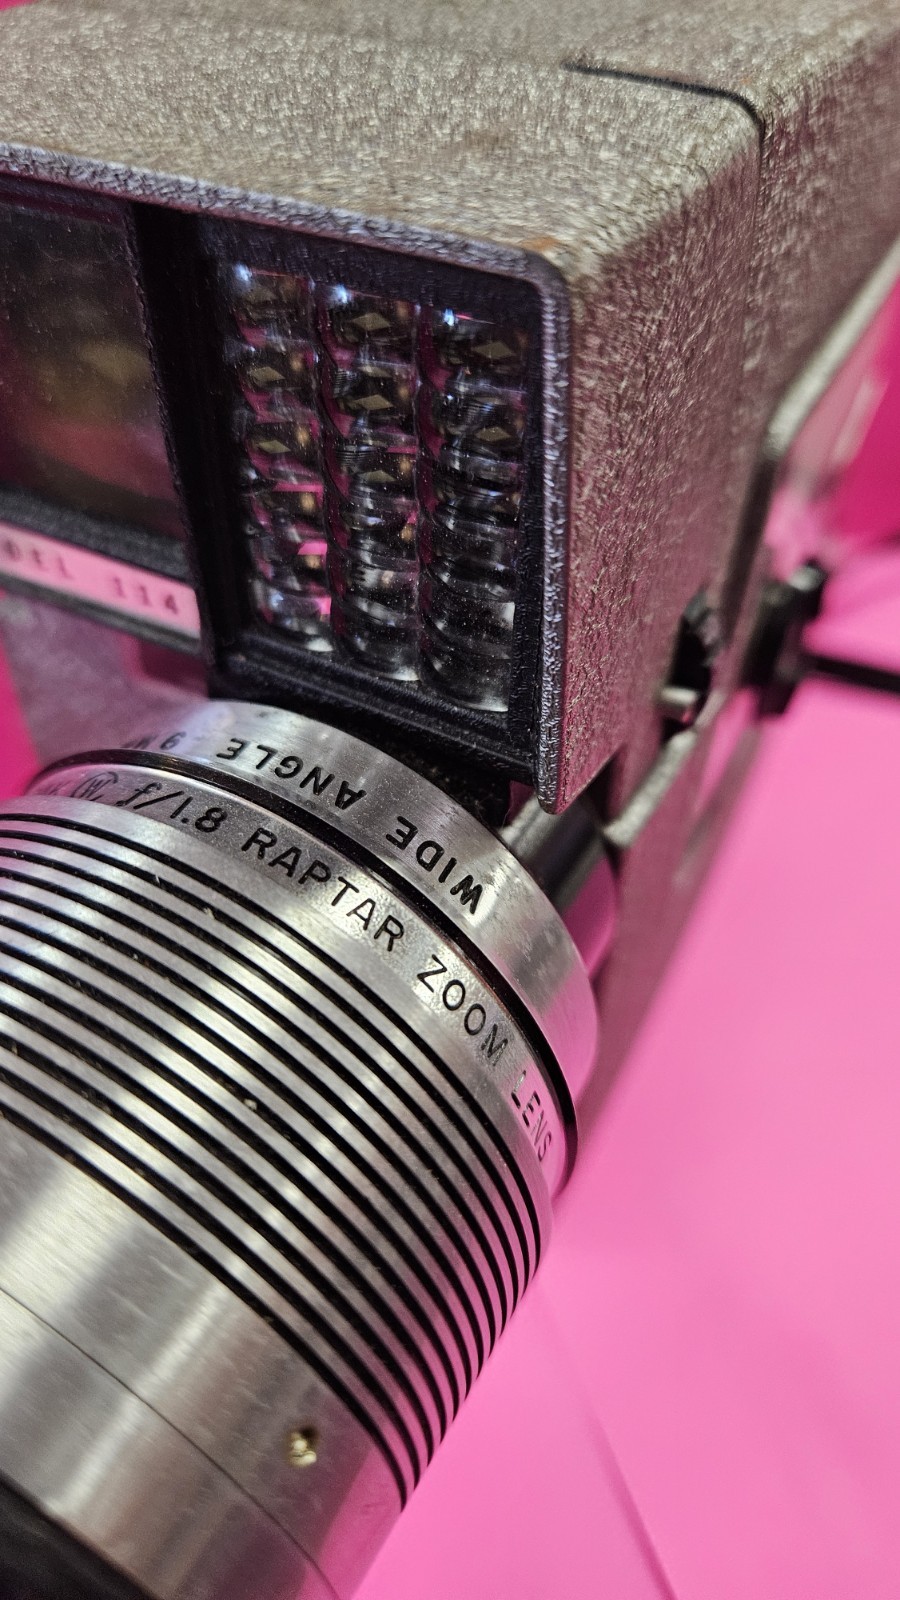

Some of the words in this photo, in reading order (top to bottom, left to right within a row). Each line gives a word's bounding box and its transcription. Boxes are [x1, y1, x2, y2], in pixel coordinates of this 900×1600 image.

[110, 576, 180, 615] 114
[216, 738, 367, 810] ANGLE
[385, 815, 483, 915] WIDE
[116, 782, 228, 833] f/1.8
[240, 827, 404, 952] RAPTAR
[416, 954, 509, 1067] ZOOM
[510, 1069, 552, 1162] LENS
